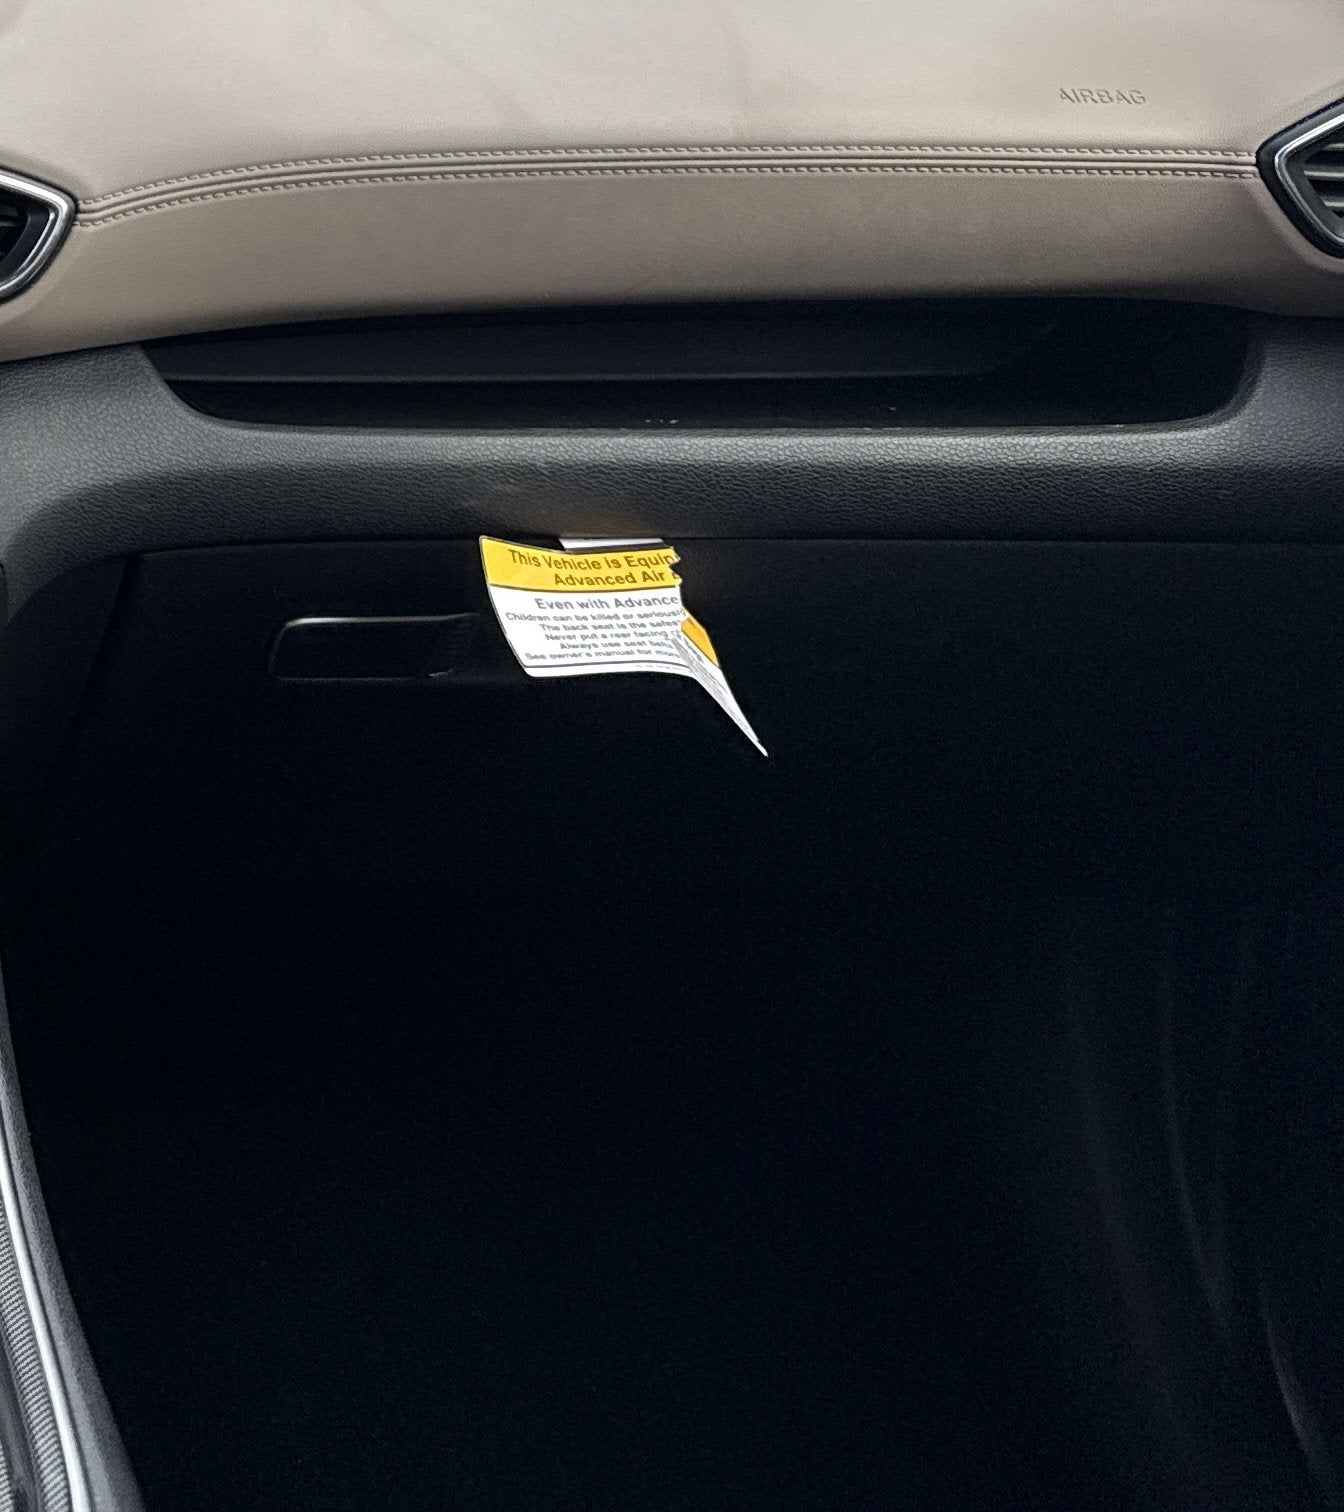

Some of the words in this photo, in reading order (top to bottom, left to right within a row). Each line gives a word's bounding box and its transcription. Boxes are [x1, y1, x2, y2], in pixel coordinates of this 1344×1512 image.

[1060, 88, 1146, 105] AIRBAG
[508, 549, 541, 568] This
[545, 555, 601, 571] Vehicle
[554, 572, 637, 586] Advanced
[642, 570, 665, 583] Air
[534, 598, 574, 609] Even
[576, 598, 610, 609] with
[505, 612, 551, 621] Children
[590, 613, 620, 621] killed
[580, 633, 599, 641] put
[633, 630, 668, 639] facing
[525, 652, 547, 660] See
[594, 649, 635, 657] manual
